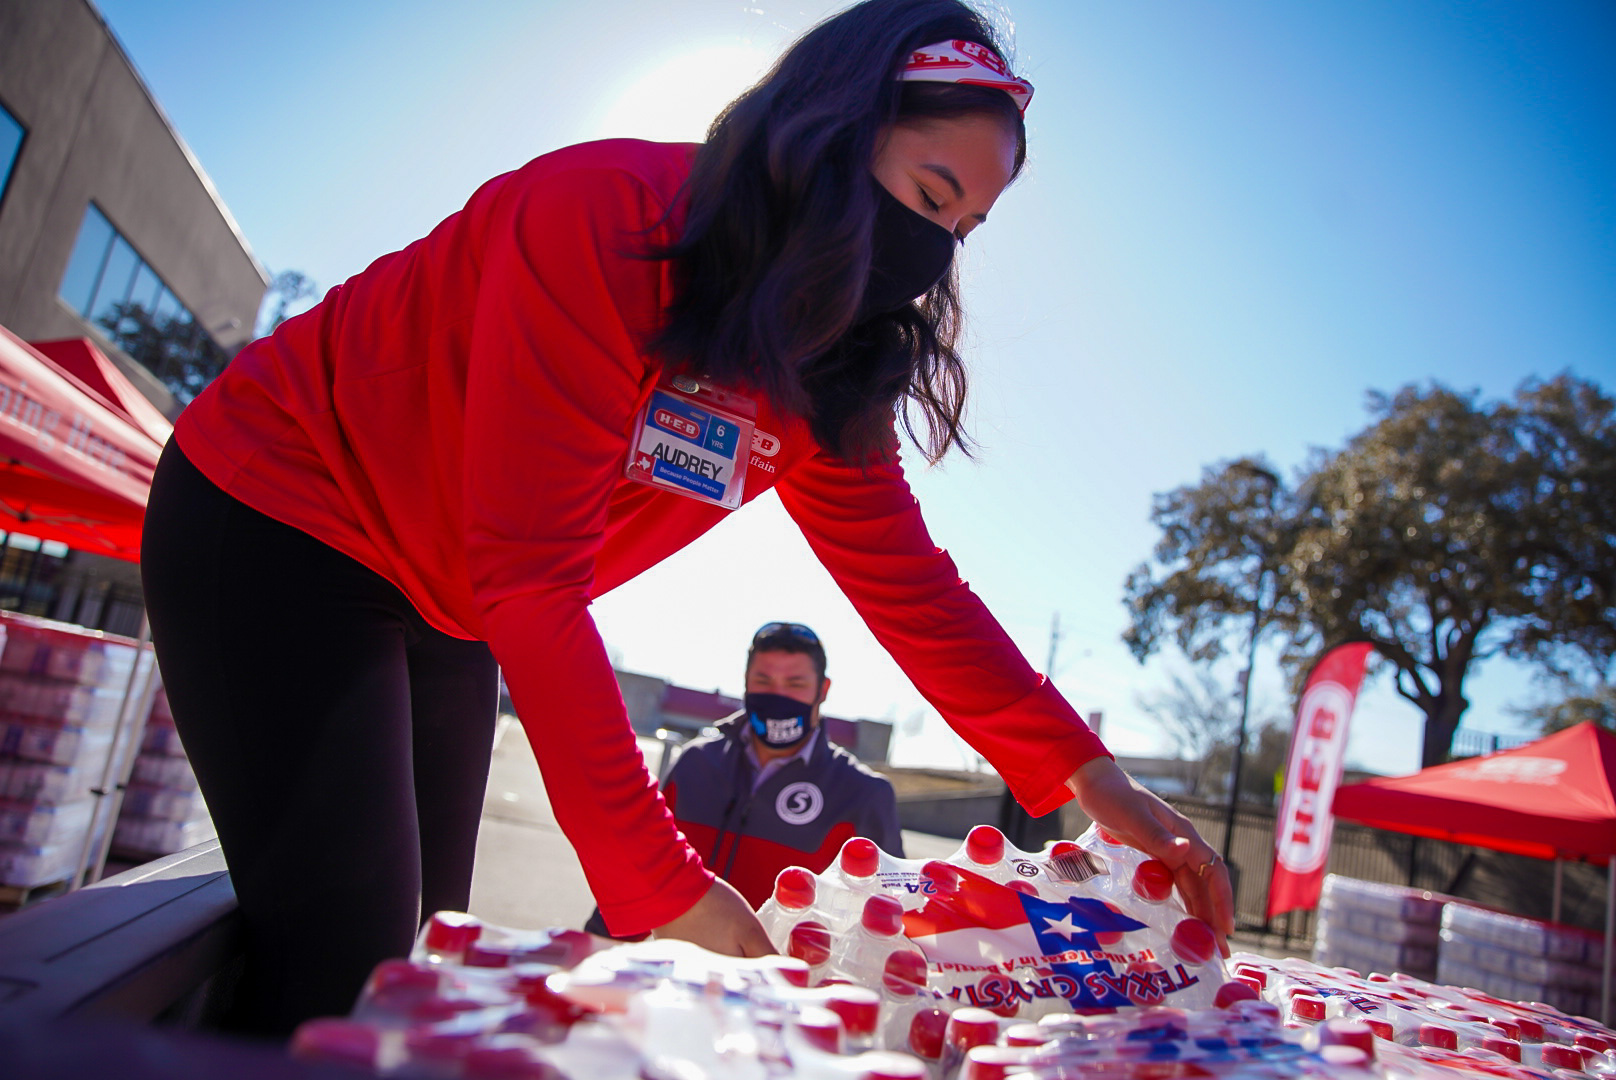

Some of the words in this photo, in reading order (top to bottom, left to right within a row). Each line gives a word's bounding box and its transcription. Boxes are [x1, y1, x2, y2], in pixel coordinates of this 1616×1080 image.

[716, 424, 725, 438] 6
[65, 411, 129, 480] Here
[711, 439, 725, 450] YRS.
[650, 442, 723, 481] AUDREY
[749, 455, 776, 474] ffairs
[659, 466, 683, 480] Because
[682, 474, 702, 488] People
[702, 482, 719, 494] Matter
[905, 880, 937, 895] 24
[1041, 949, 1093, 965] Texas
[1092, 950, 1128, 964] like
[1127, 948, 1156, 964] It's
[936, 962, 1000, 974] Bottle!
[1002, 958, 1015, 973] A
[1084, 963, 1199, 1000] TEXAS
[940, 974, 1079, 1008] CRYST
